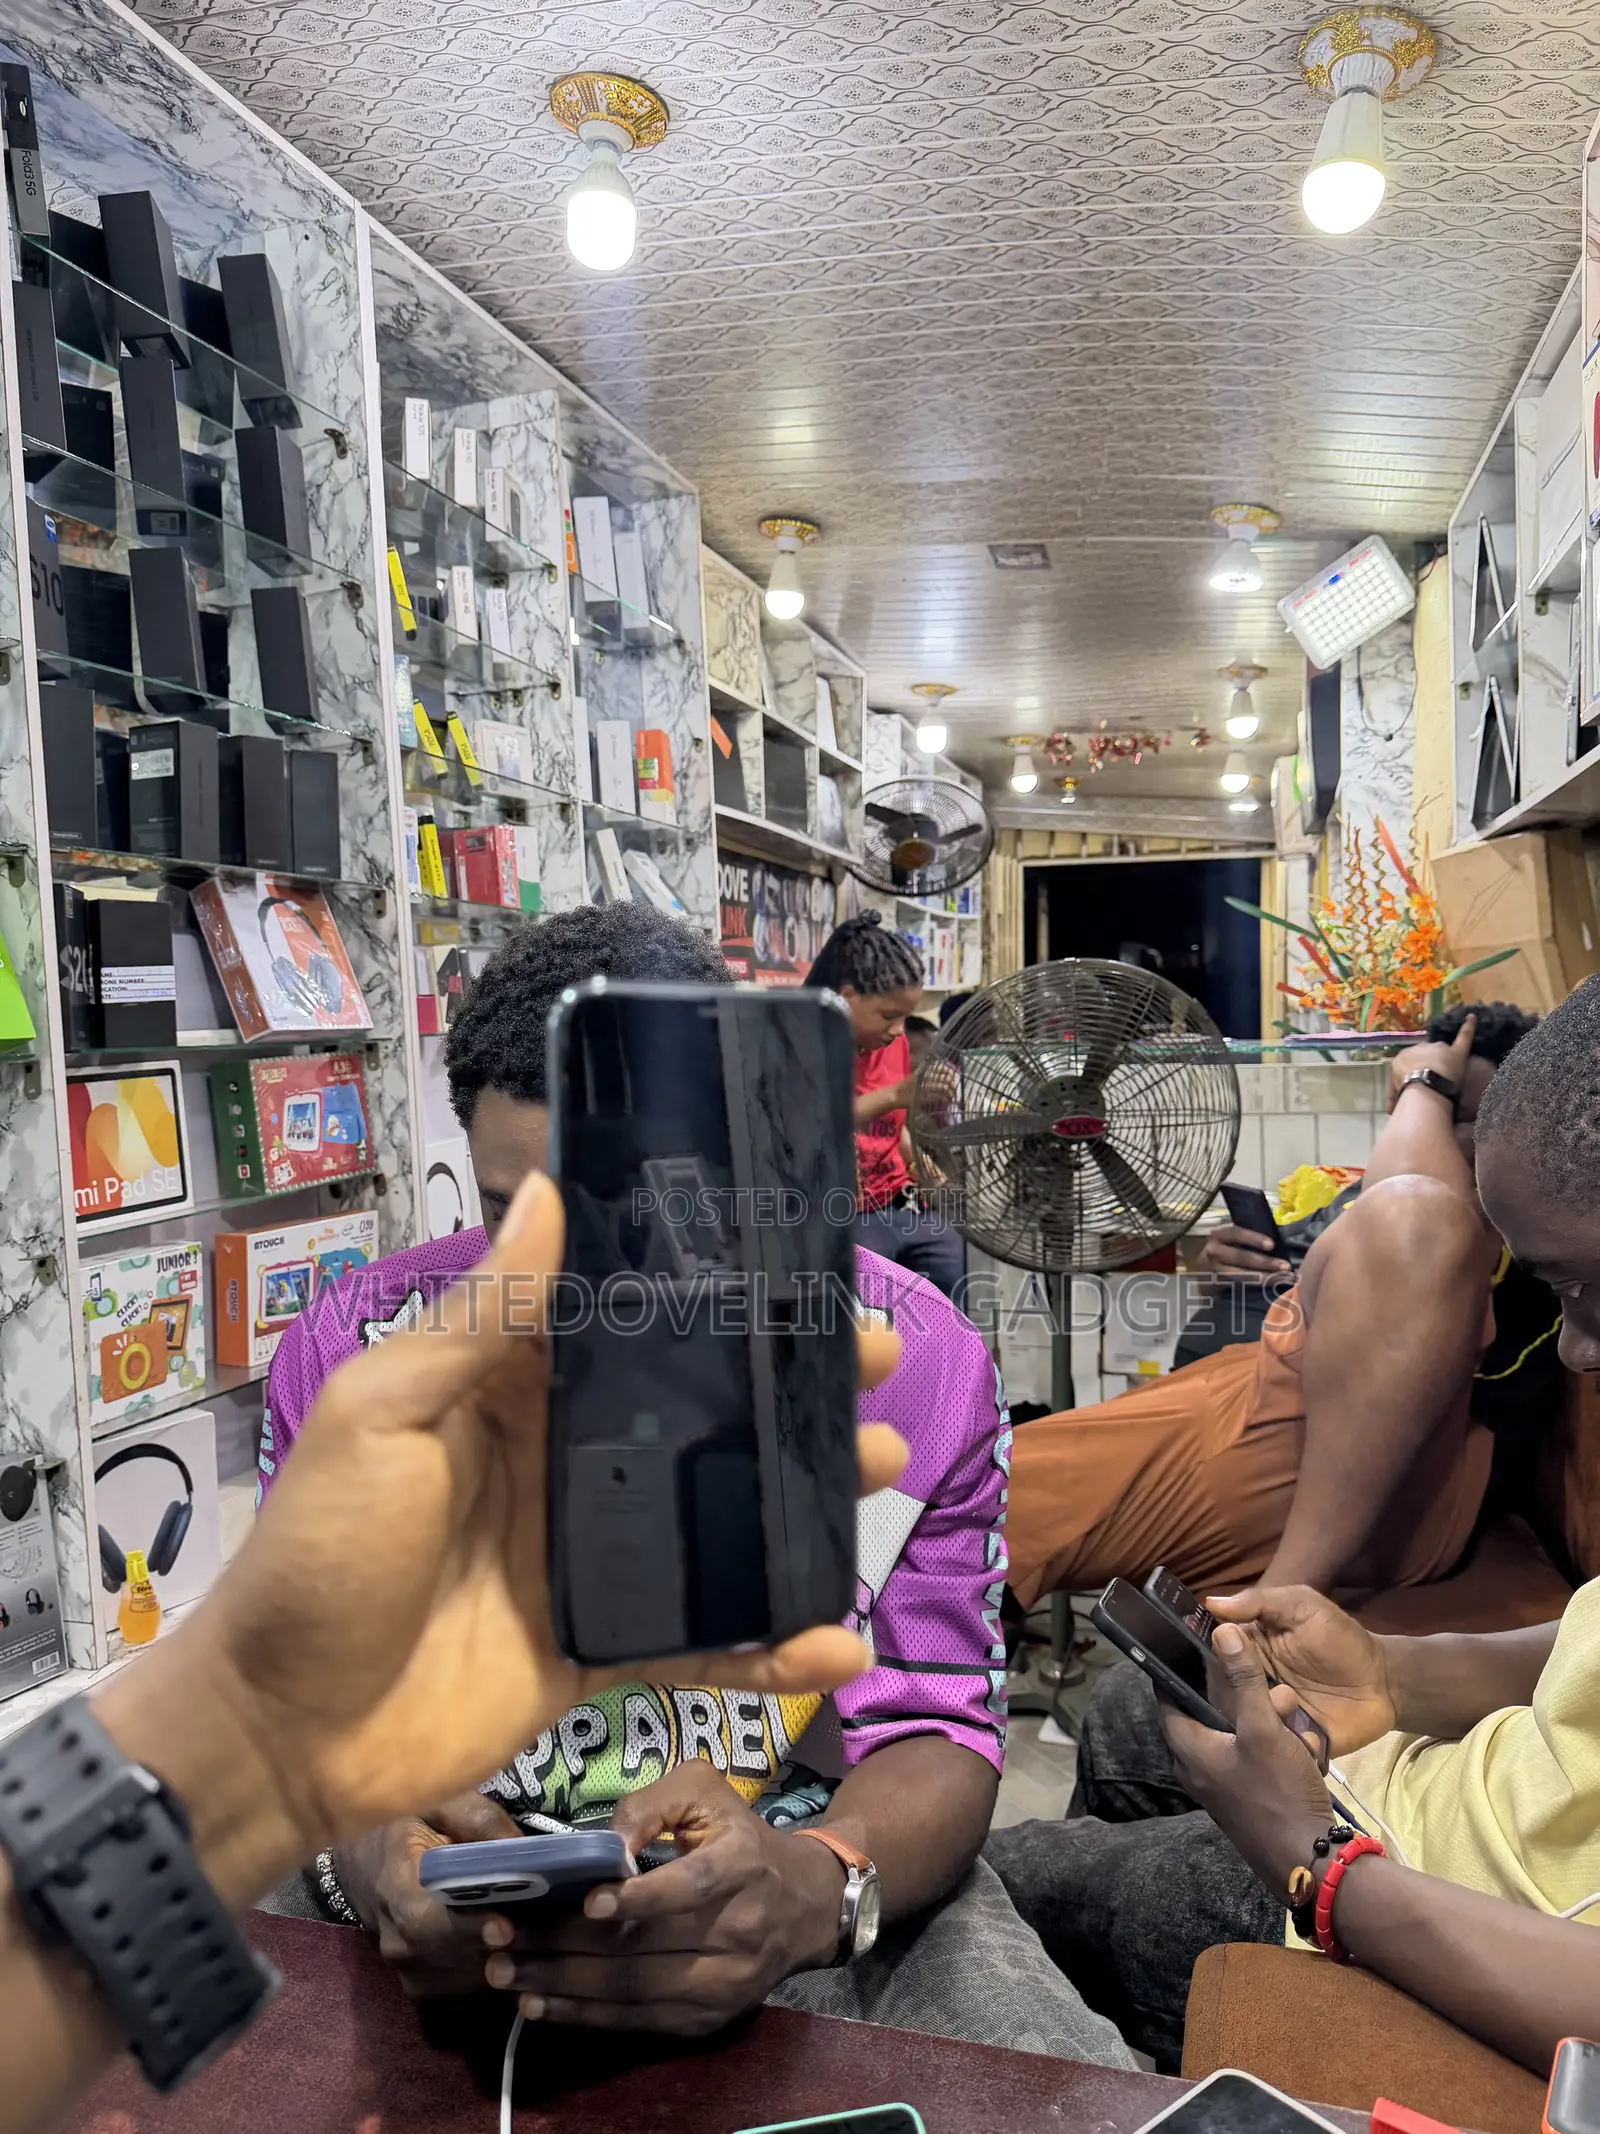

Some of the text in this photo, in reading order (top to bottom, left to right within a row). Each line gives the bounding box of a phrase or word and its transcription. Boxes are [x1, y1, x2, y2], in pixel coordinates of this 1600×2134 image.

[21, 149, 37, 197] Fold3 5G
[103, 1169, 147, 1204] Pad
[151, 1167, 179, 1193] SE
[156, 1251, 192, 1273] JUNIOR
